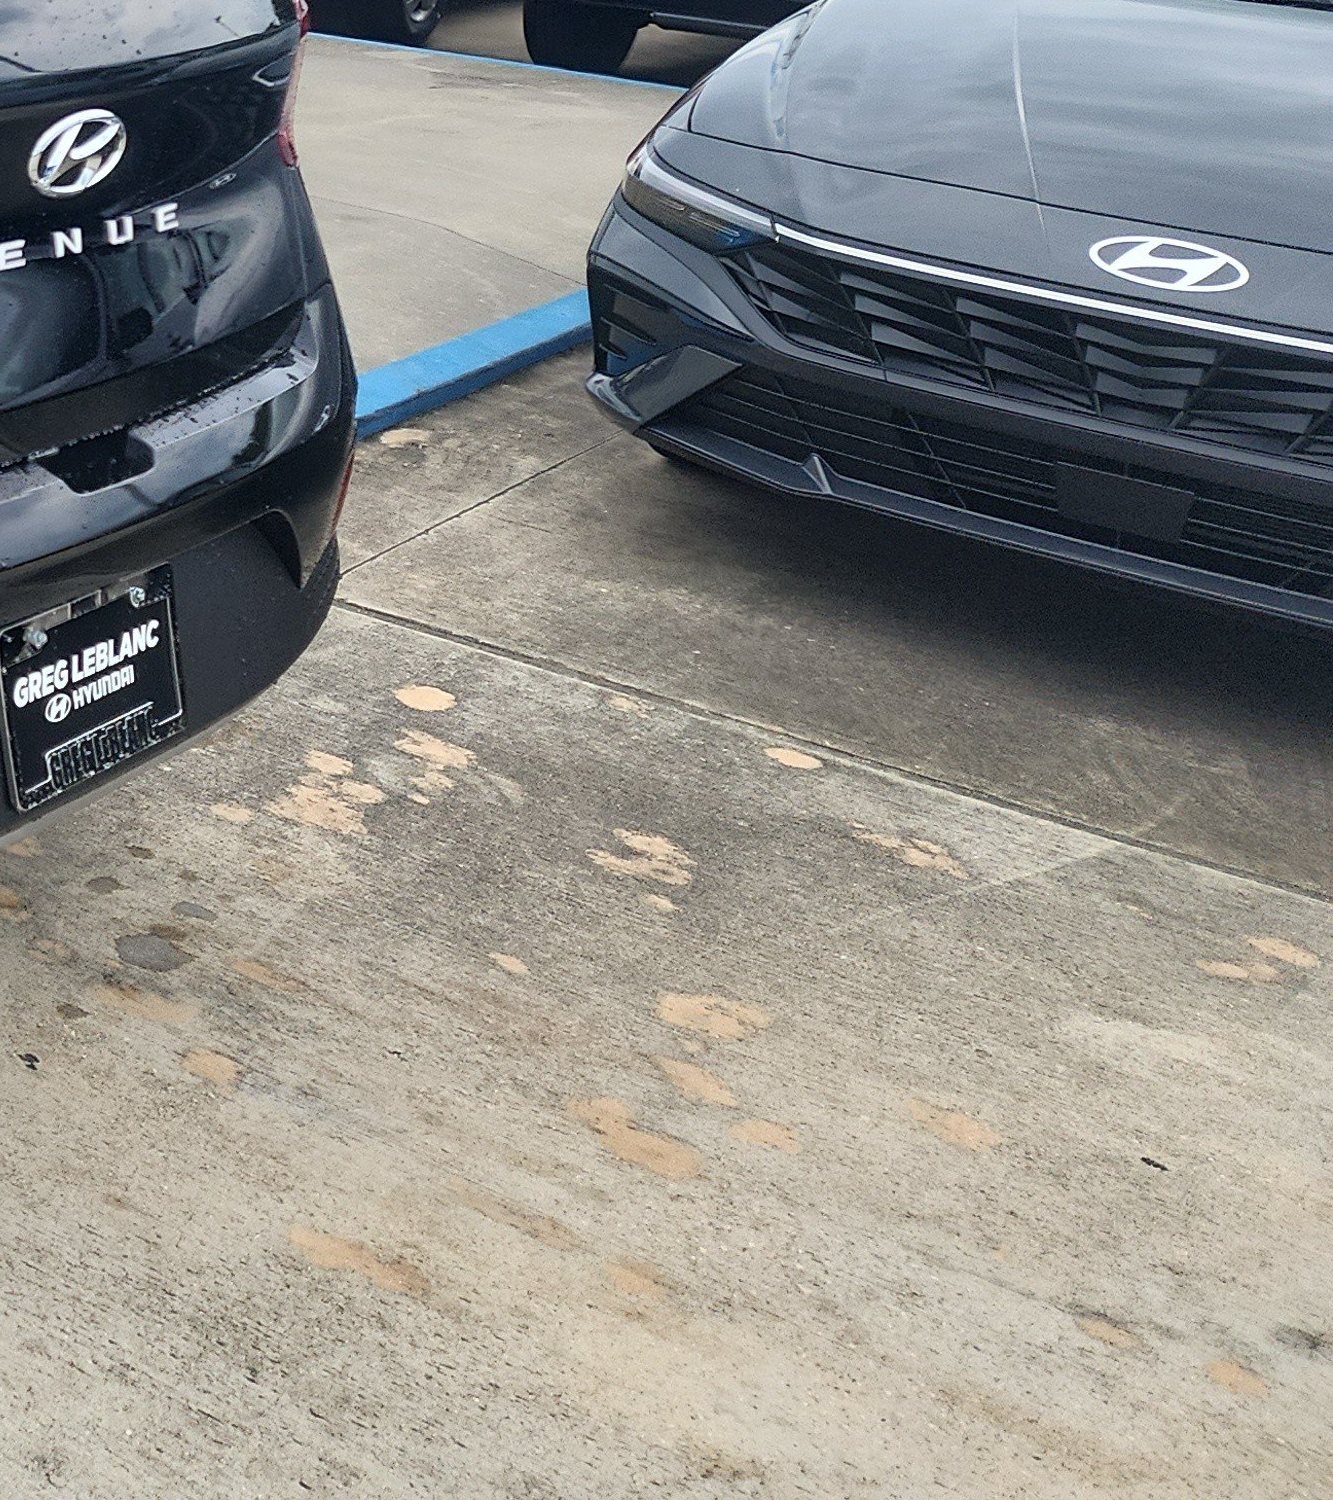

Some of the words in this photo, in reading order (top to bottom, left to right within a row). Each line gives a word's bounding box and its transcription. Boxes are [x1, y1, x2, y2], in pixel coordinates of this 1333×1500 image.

[13, 659, 69, 708] GREG
[71, 619, 160, 683] LEBLANC
[72, 664, 135, 710] HYUNDAI
[49, 741, 95, 792] GREG
